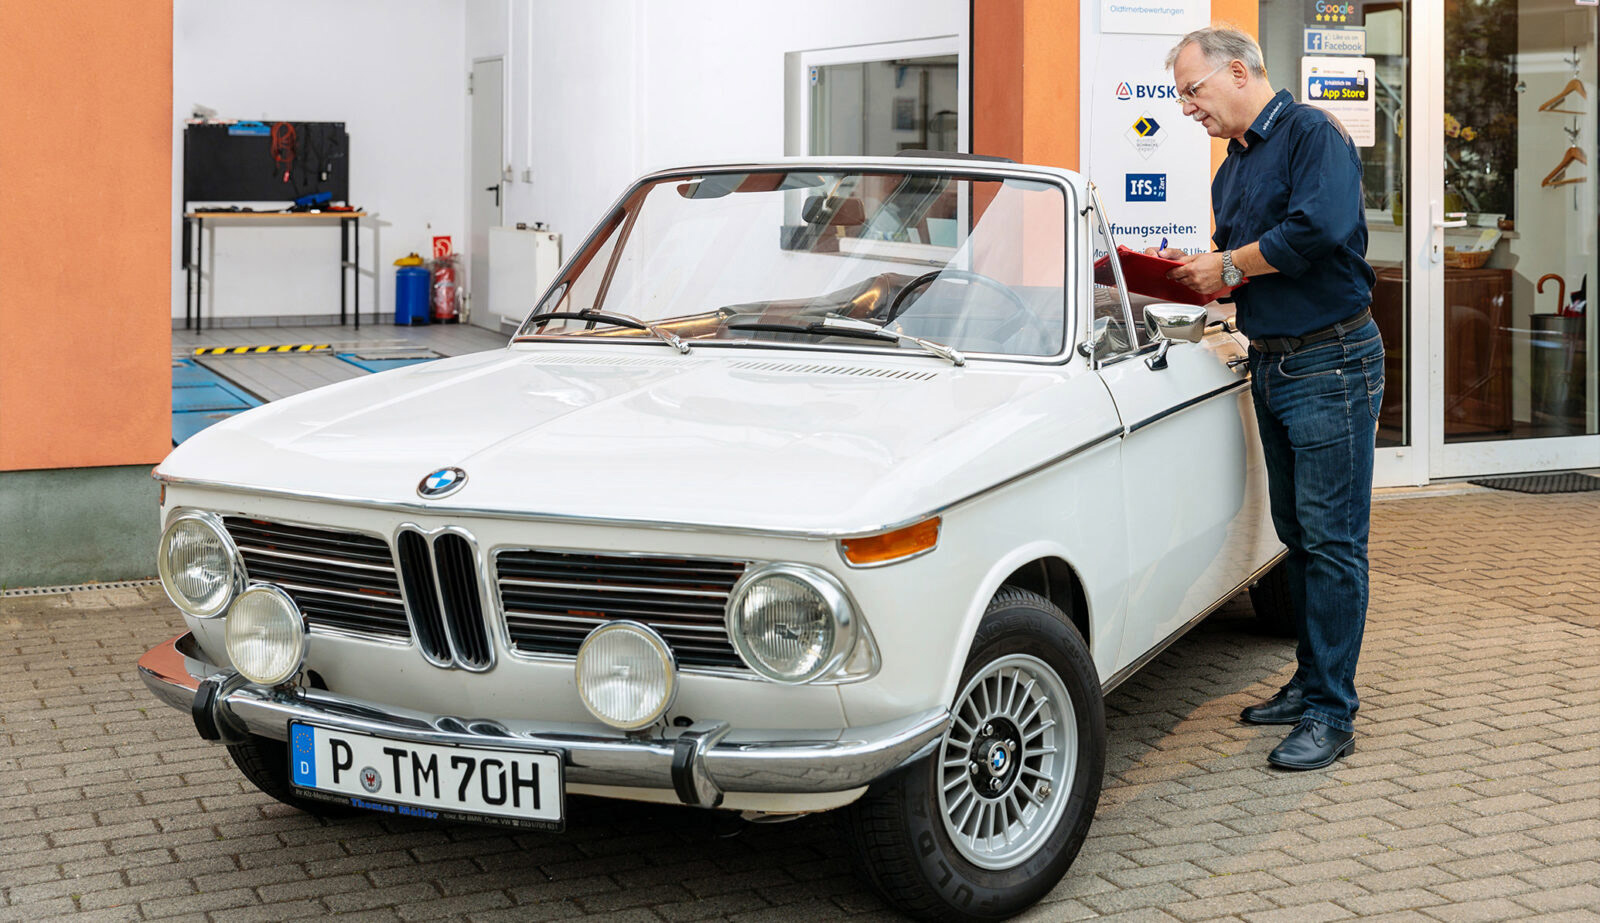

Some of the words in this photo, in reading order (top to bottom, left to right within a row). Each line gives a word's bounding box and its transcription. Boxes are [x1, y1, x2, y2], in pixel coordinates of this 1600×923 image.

[1315, 0, 1355, 15] Google
[1324, 41, 1362, 51] Facebook
[1136, 84, 1177, 99] BVSK
[1323, 88, 1340, 99] App
[1341, 88, 1365, 98] Store
[1098, 222, 1198, 238] fnungszeiten:
[300, 761, 310, 775] D
[328, 737, 353, 784] P
[383, 746, 440, 800] TM
[450, 754, 541, 811] 70H
[350, 797, 396, 814] Thomas
[911, 793, 1000, 912] FULDA
